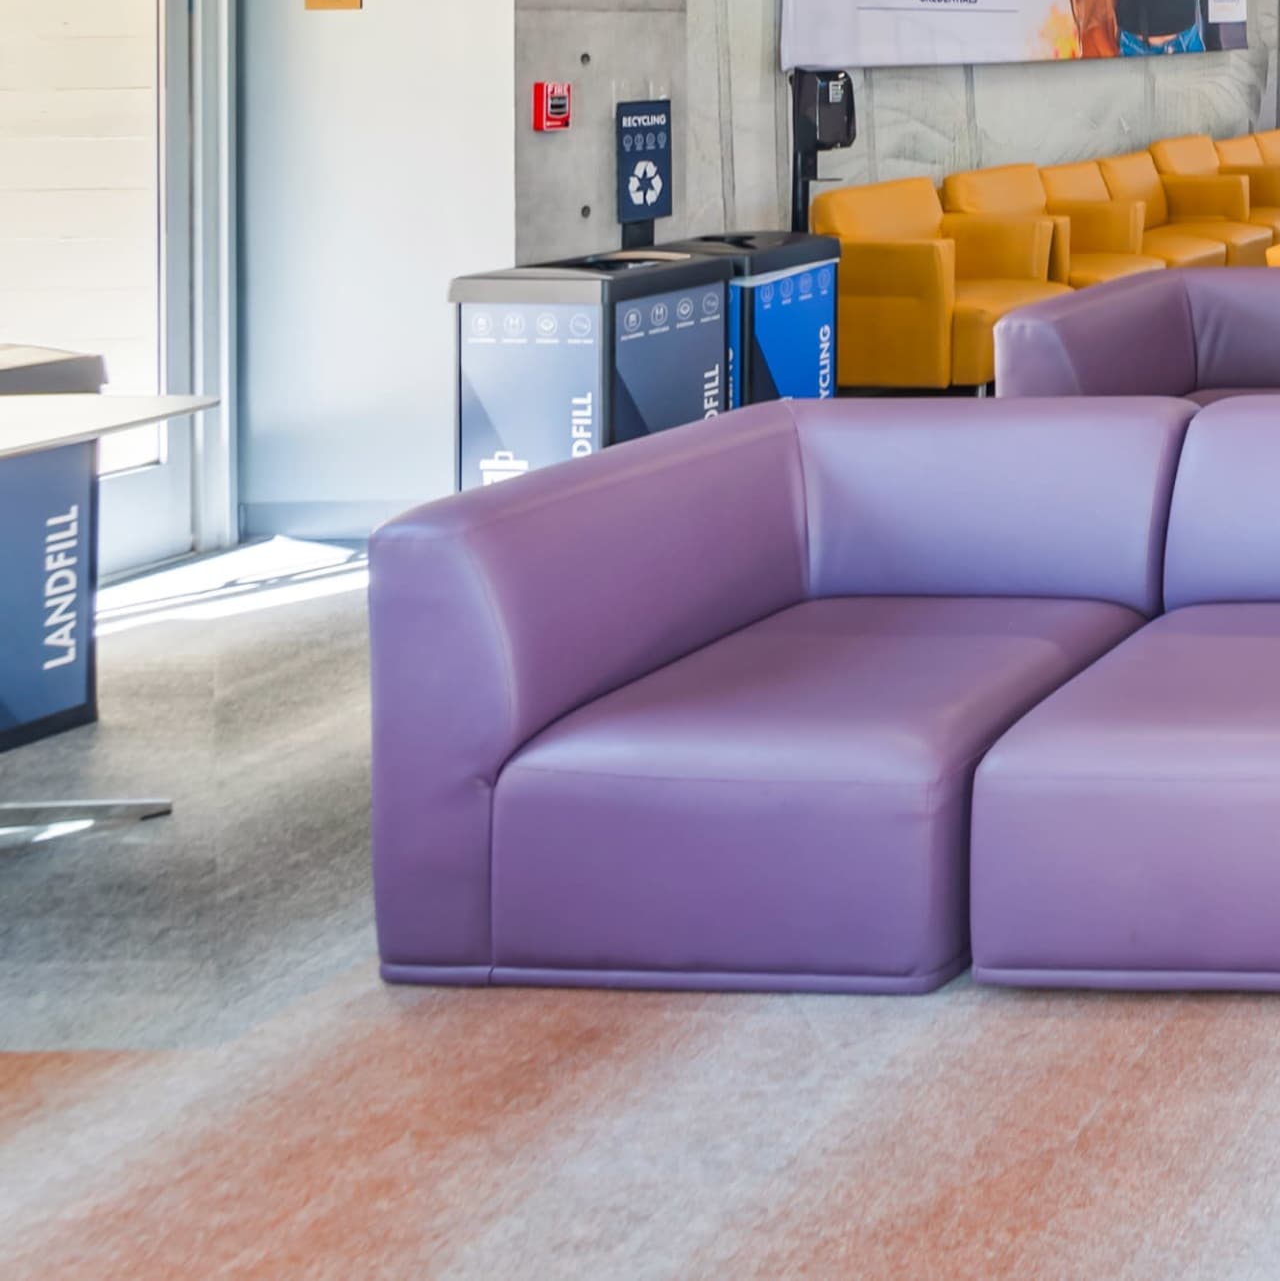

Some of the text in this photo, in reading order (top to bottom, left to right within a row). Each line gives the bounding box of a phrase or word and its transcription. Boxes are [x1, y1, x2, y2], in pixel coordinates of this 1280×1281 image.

[547, 84, 568, 95] FIRE
[622, 114, 667, 128] RECYCLING
[43, 504, 79, 670] LANDFILL
